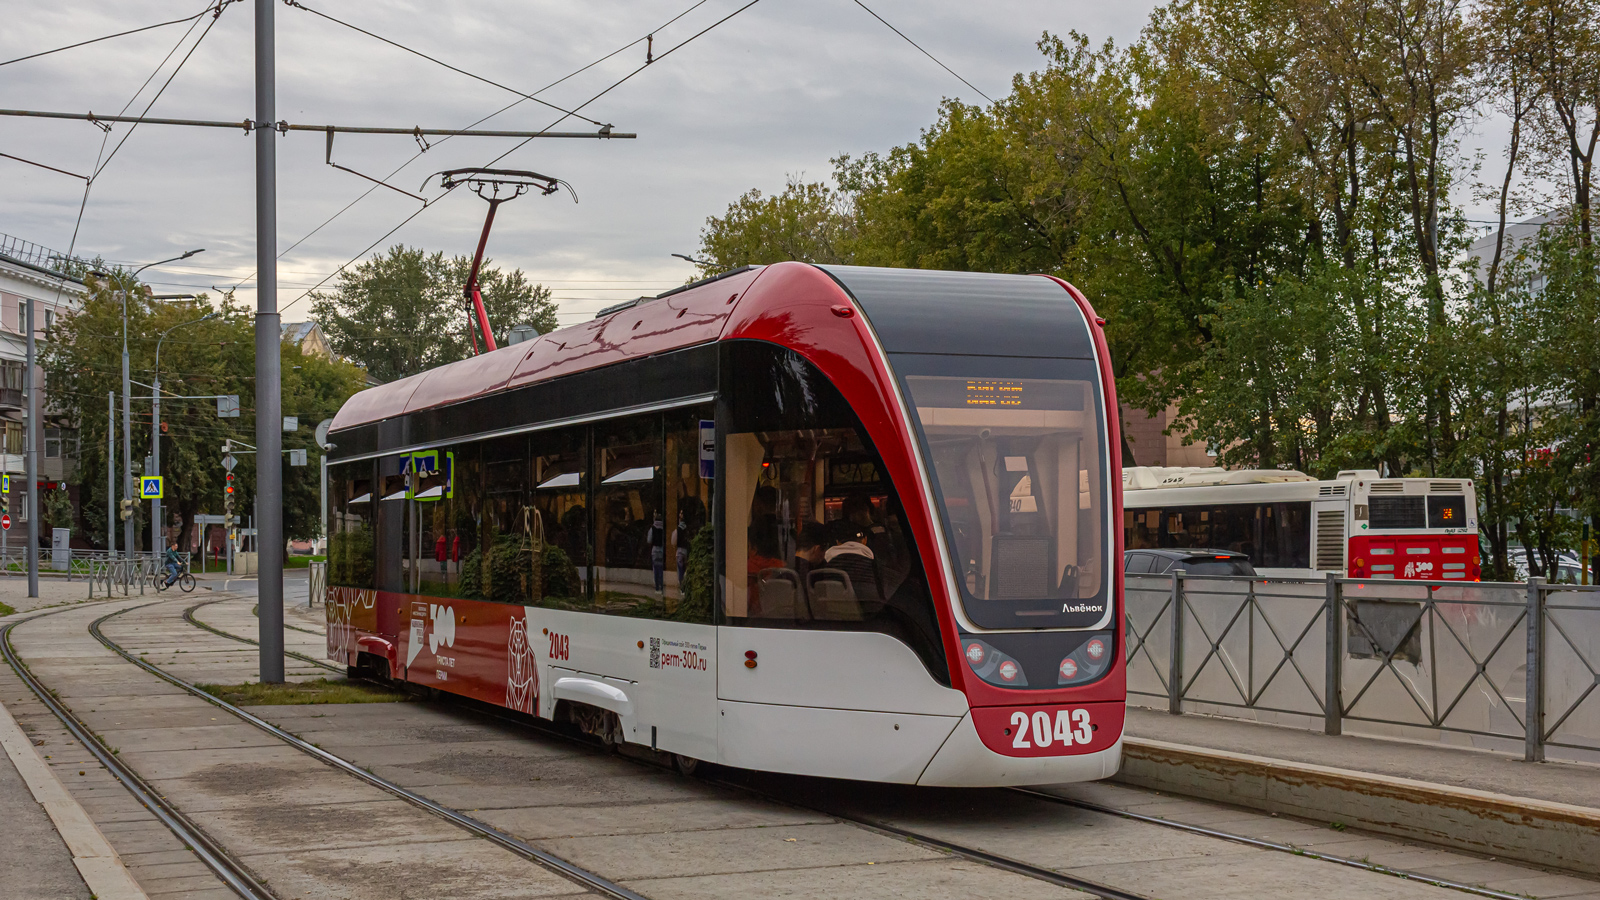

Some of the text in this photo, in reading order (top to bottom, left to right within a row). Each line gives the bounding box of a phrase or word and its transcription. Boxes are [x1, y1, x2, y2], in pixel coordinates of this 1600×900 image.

[1062, 603, 1103, 613] Львёнок
[549, 631, 569, 661] 2043
[661, 650, 707, 671] perm-300.ru
[1010, 708, 1093, 749] 2043
